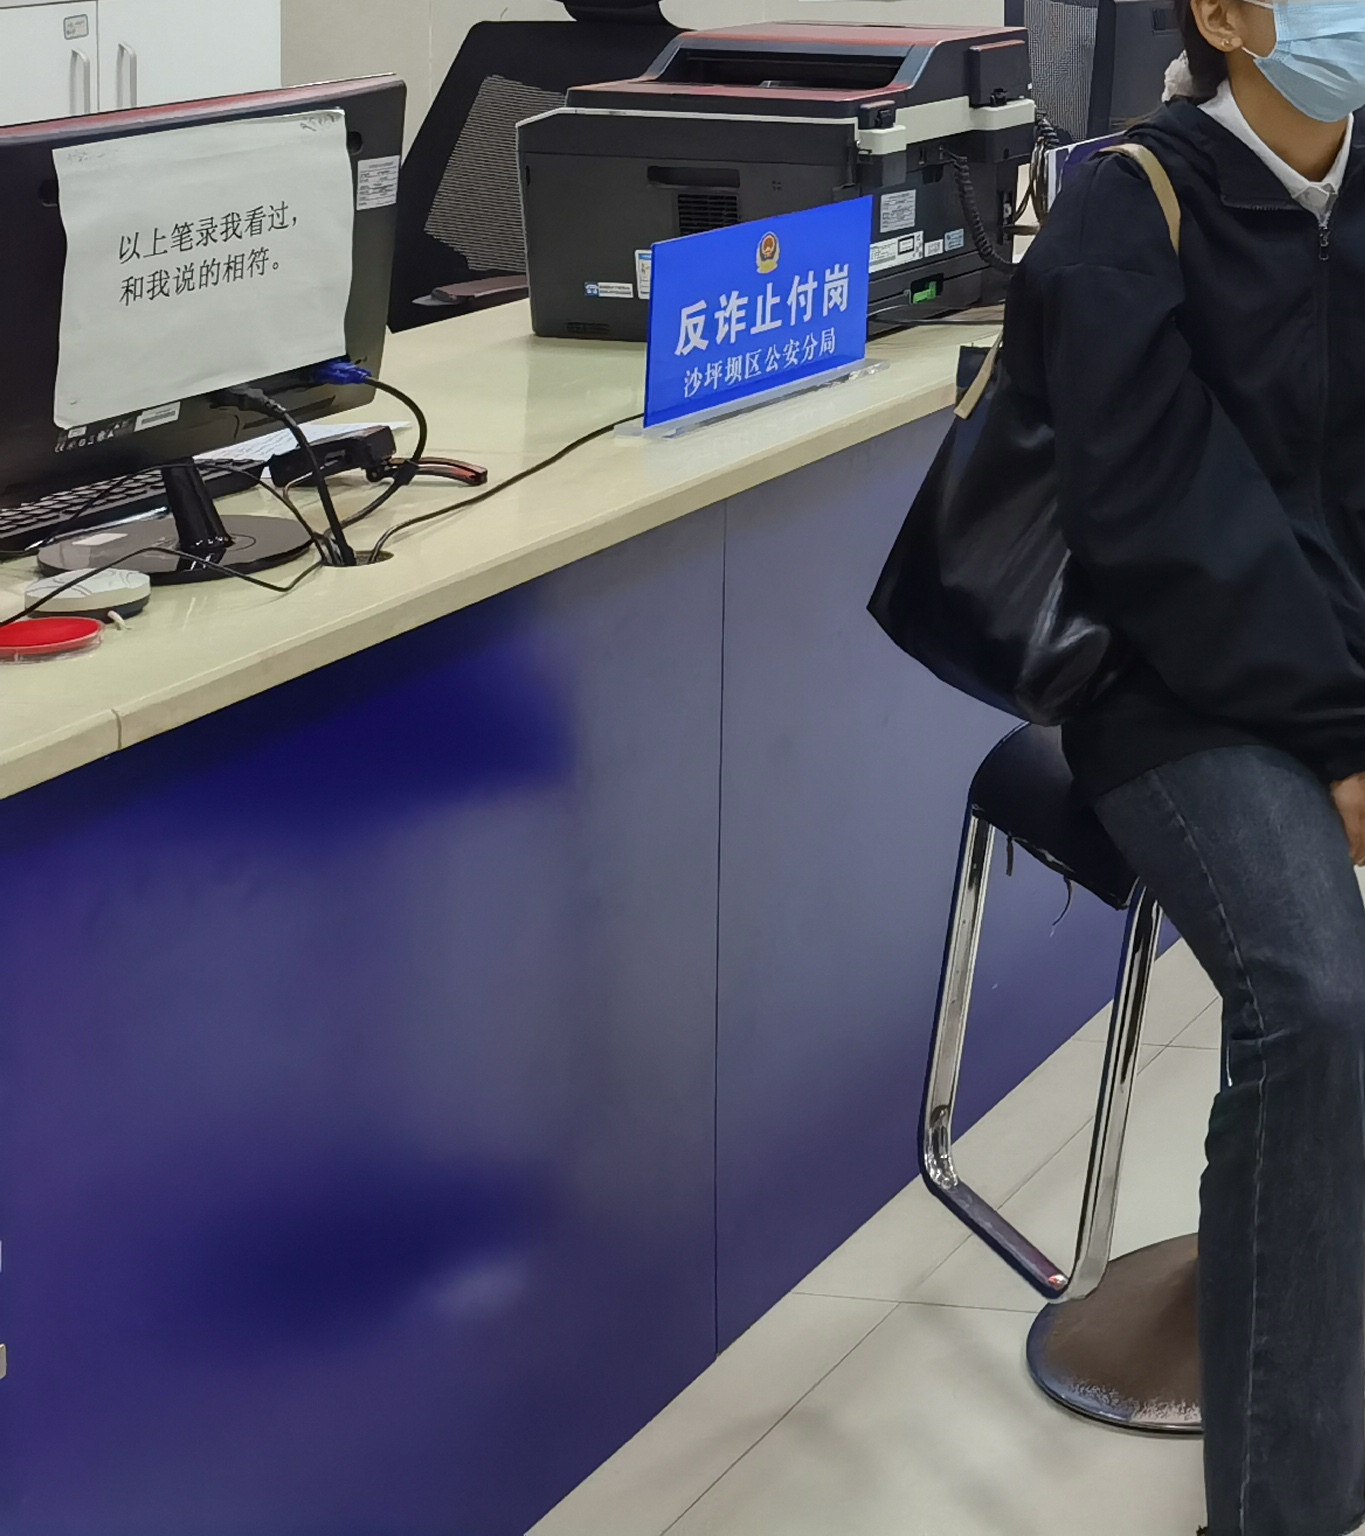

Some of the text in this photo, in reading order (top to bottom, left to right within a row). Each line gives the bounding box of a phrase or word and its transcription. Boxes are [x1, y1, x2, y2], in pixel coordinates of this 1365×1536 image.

[117, 201, 299, 265] 以上笔录我看过，
[120, 246, 283, 308] 和我说的相符。
[674, 263, 849, 357] 反诈止付岗
[683, 327, 836, 399] 沙坪坝区公安分局
